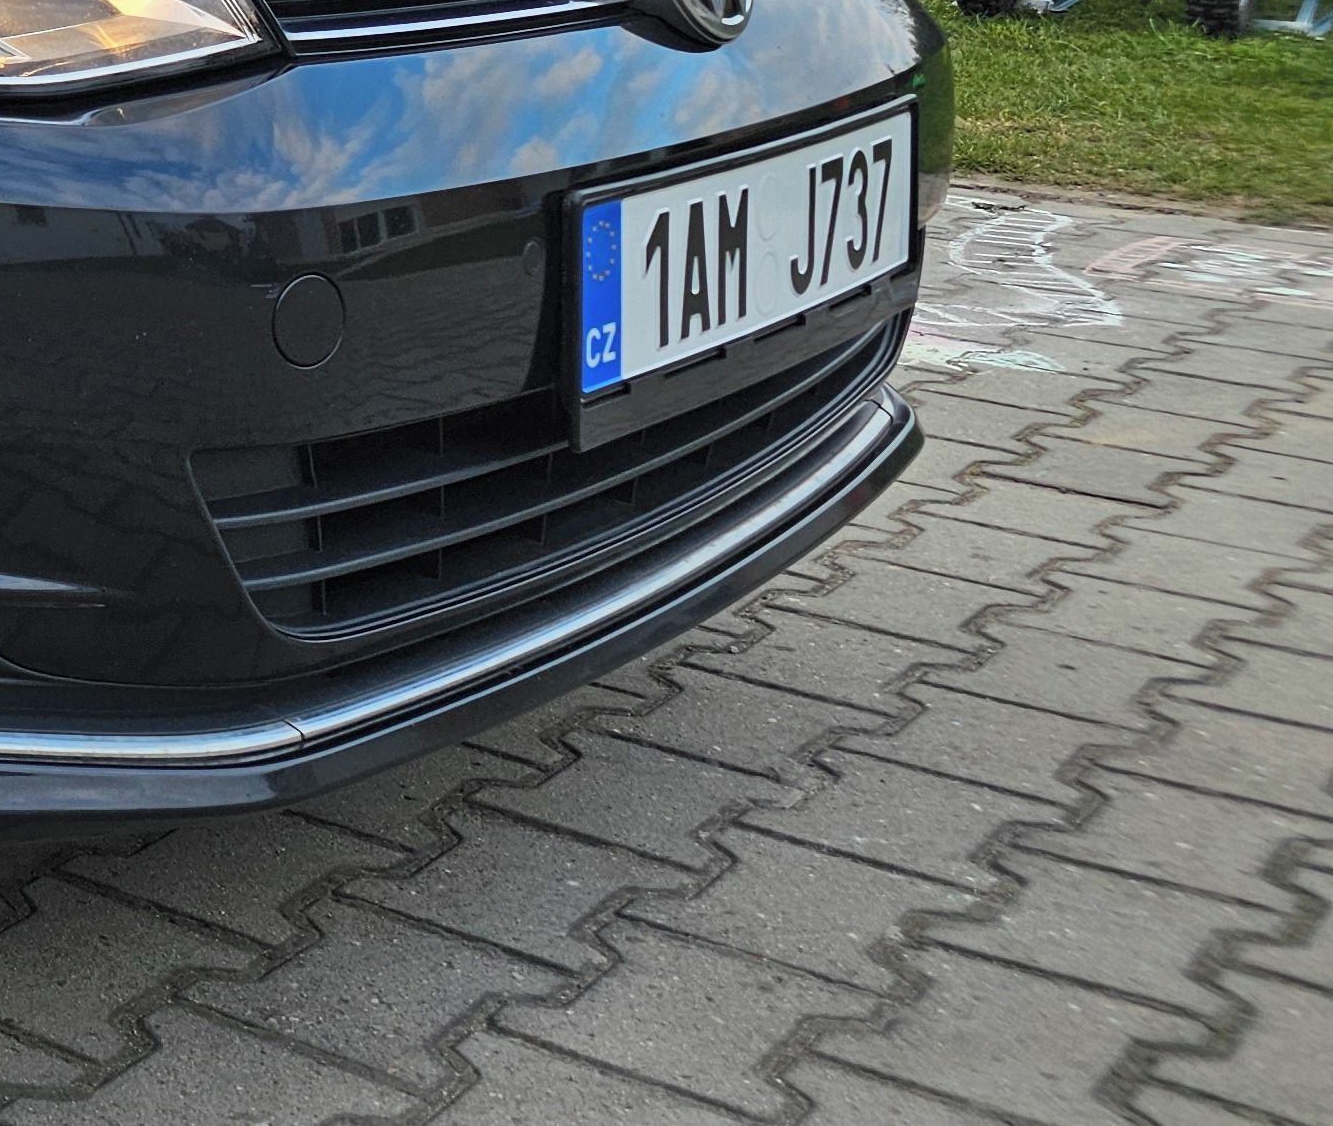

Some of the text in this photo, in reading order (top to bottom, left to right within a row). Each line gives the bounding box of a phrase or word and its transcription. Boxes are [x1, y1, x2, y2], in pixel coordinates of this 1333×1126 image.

[645, 137, 893, 349] 1AM J737
[585, 321, 617, 368] CZ
